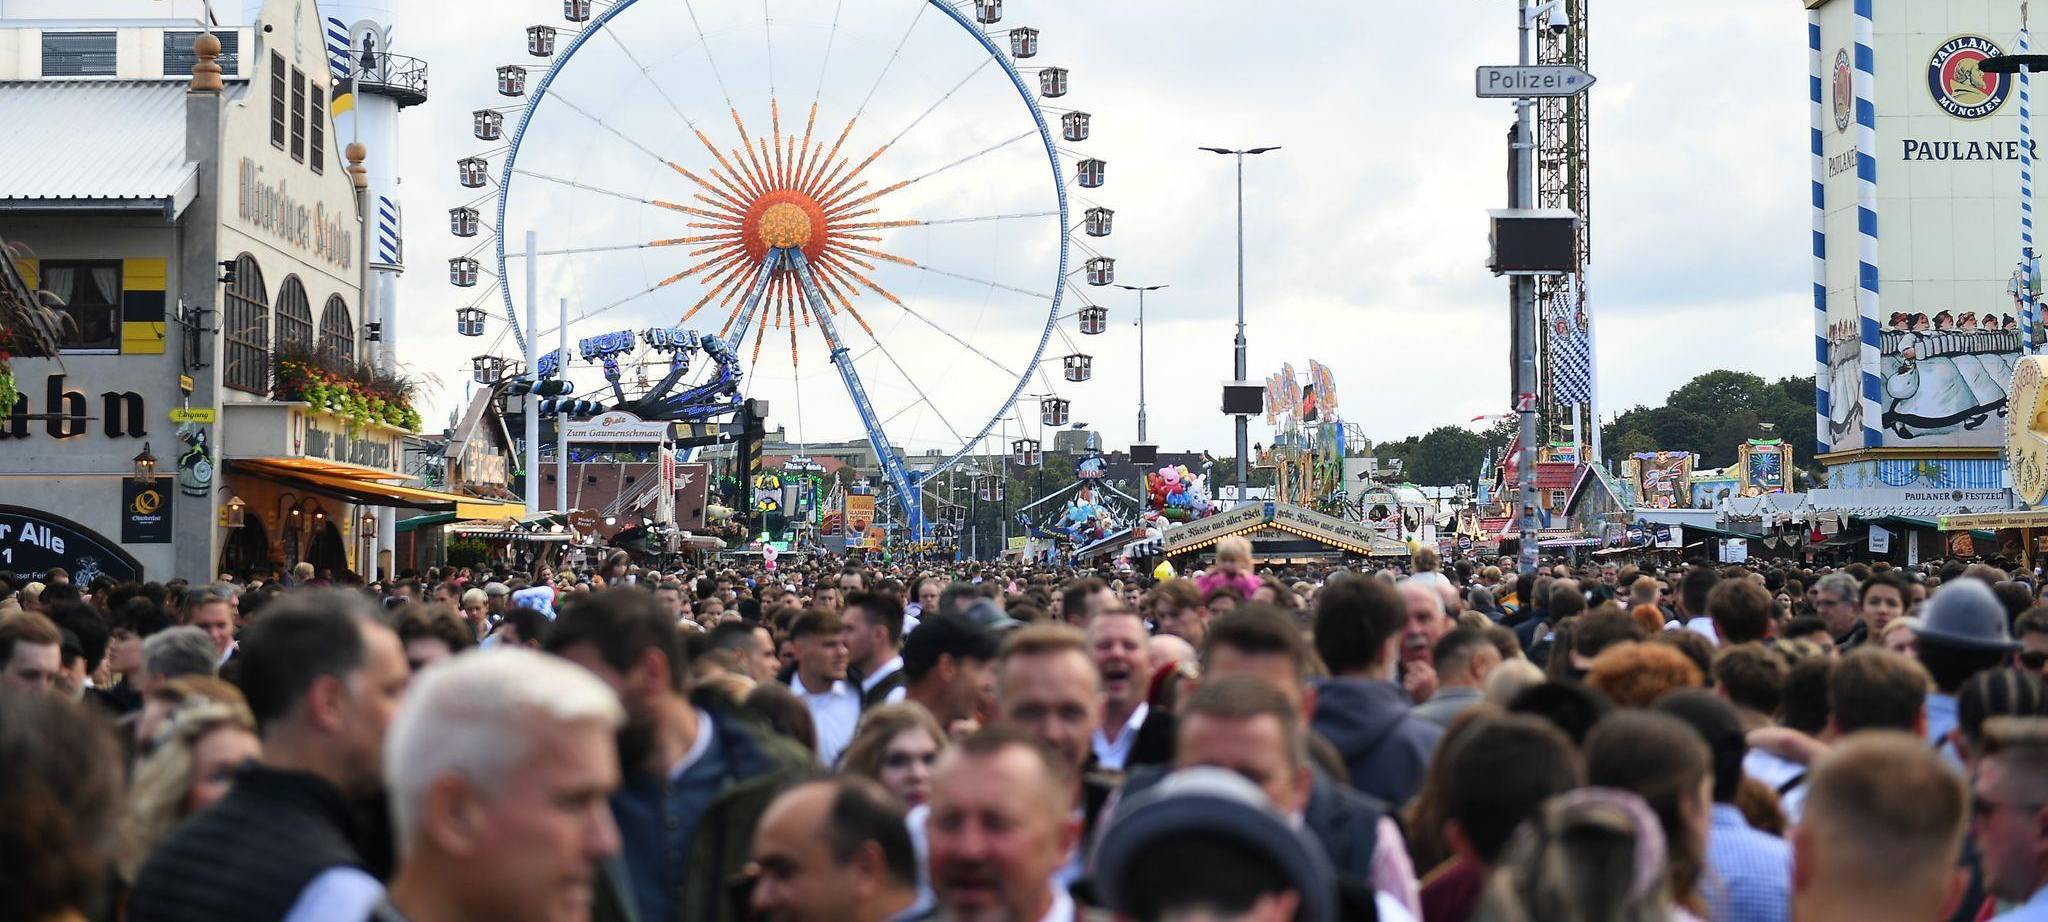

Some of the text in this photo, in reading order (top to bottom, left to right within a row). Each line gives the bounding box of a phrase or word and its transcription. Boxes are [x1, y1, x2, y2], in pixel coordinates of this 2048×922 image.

[1931, 38, 2003, 68] PAULANE
[1489, 70, 1561, 89] Polizei
[1938, 95, 2002, 117] MÜNCHEN
[1828, 144, 1857, 178] PAULANE
[1902, 139, 2039, 161] PAULANER
[566, 427, 663, 440] Zum Gaumenschmaus
[1905, 492, 2004, 501] PAULANER FESTZELT
[20, 522, 65, 554] Alle
